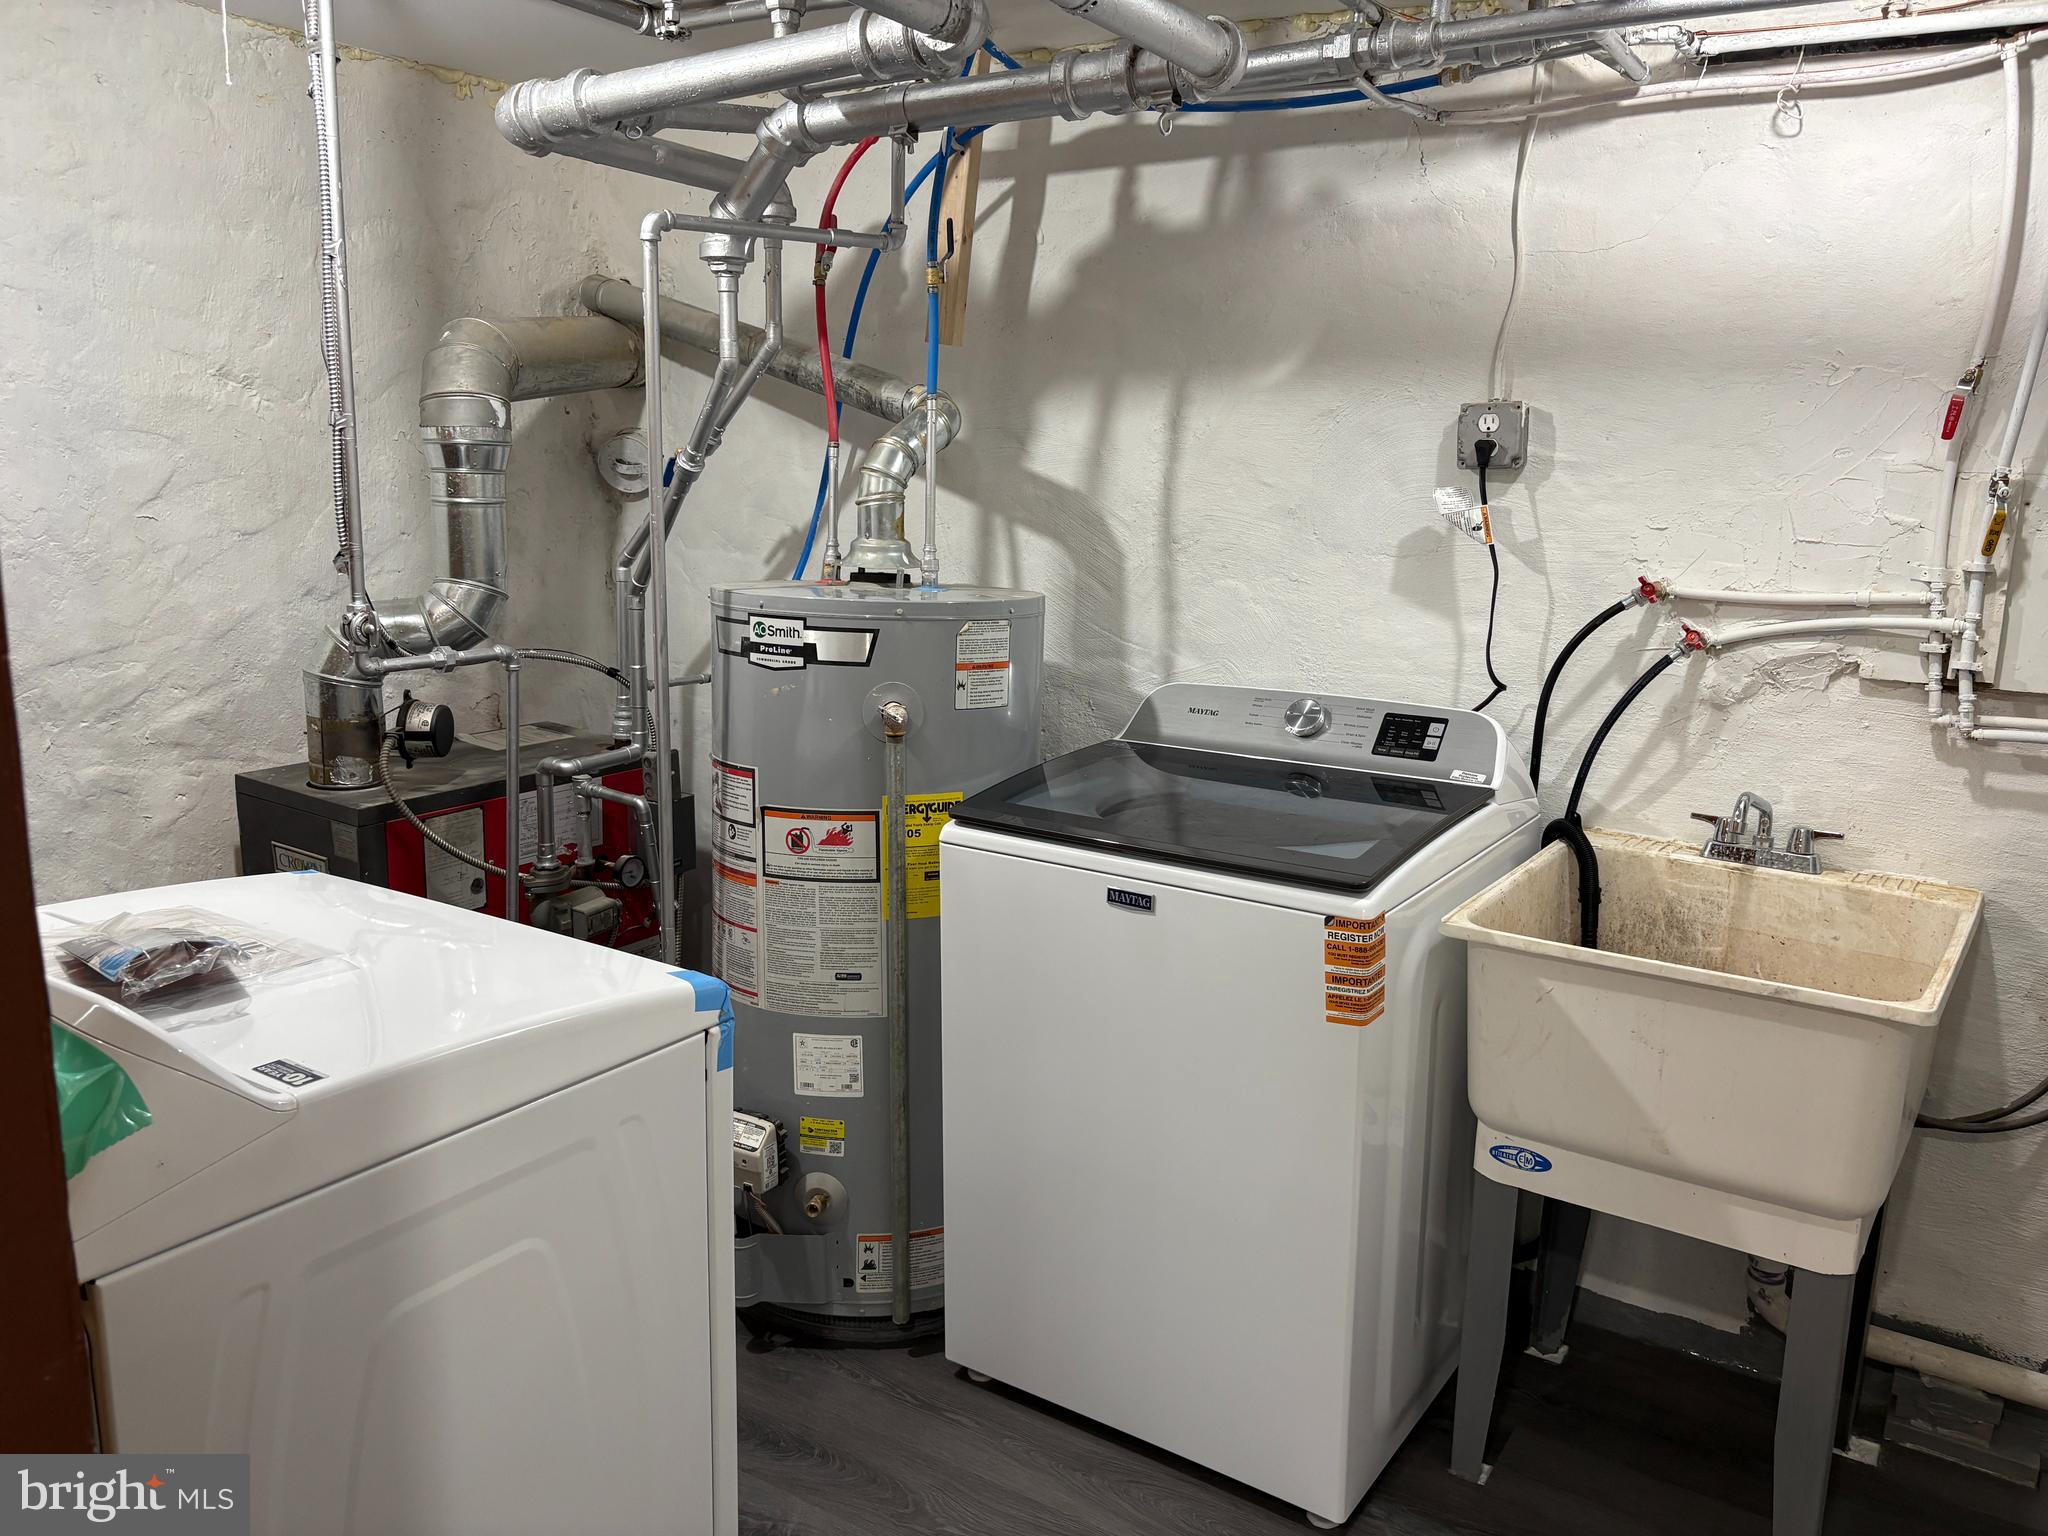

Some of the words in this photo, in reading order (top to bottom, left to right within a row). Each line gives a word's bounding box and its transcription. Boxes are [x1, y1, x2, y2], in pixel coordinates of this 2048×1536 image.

[760, 644, 791, 655] ProLine
[1188, 706, 1219, 717] MAYTAG
[1109, 890, 1150, 908] MAYTAG
[1327, 931, 1373, 943] REGISTER
[1326, 943, 1346, 952] CALL
[256, 1066, 283, 1078] YEAR
[281, 1072, 314, 1086] 10
